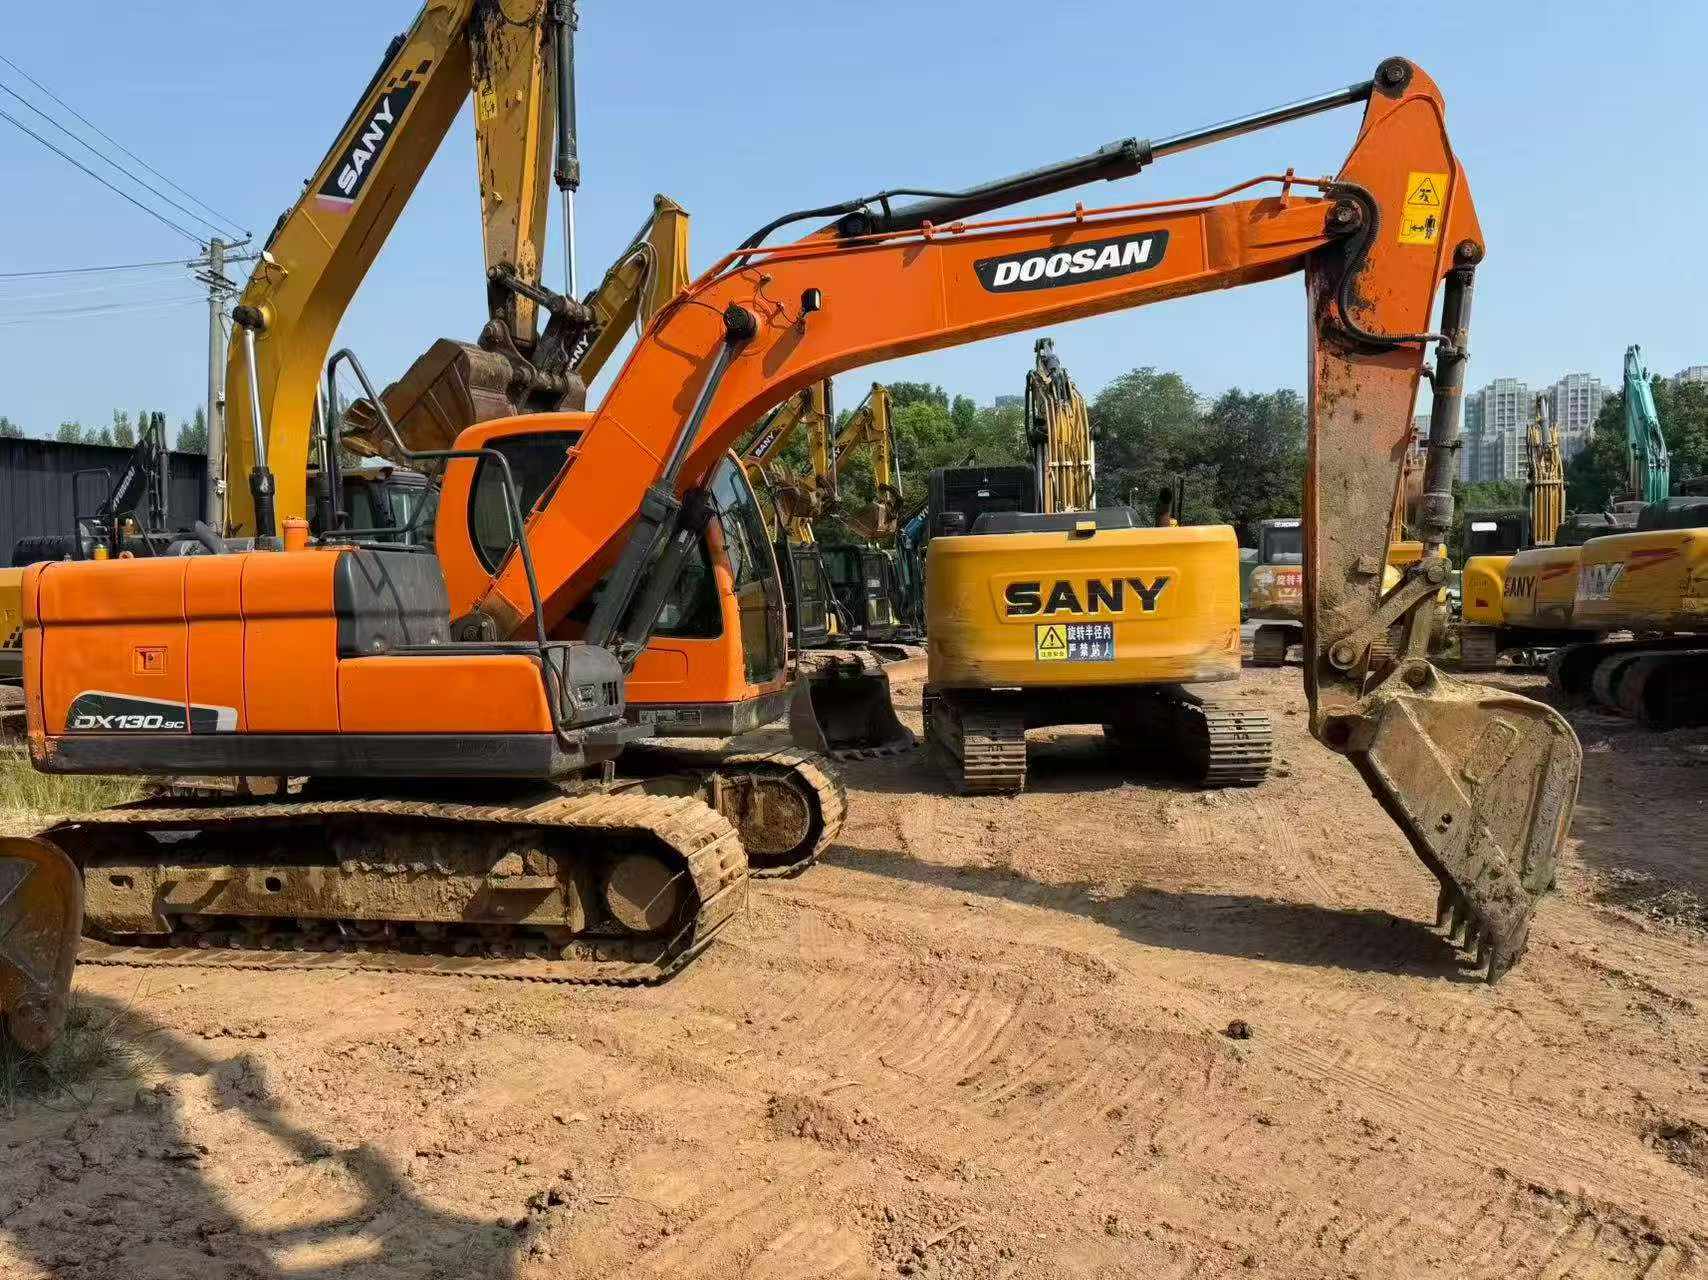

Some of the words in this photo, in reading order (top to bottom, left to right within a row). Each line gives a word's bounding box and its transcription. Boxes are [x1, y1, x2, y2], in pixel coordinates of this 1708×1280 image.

[338, 96, 394, 195] SANY
[993, 239, 1153, 287] DOOSAN
[567, 334, 589, 370] ANY
[755, 431, 775, 457] SANY
[1004, 575, 1171, 616] SANY
[1504, 576, 1536, 598] SANY
[1067, 625, 1111, 640] 旋转半径内
